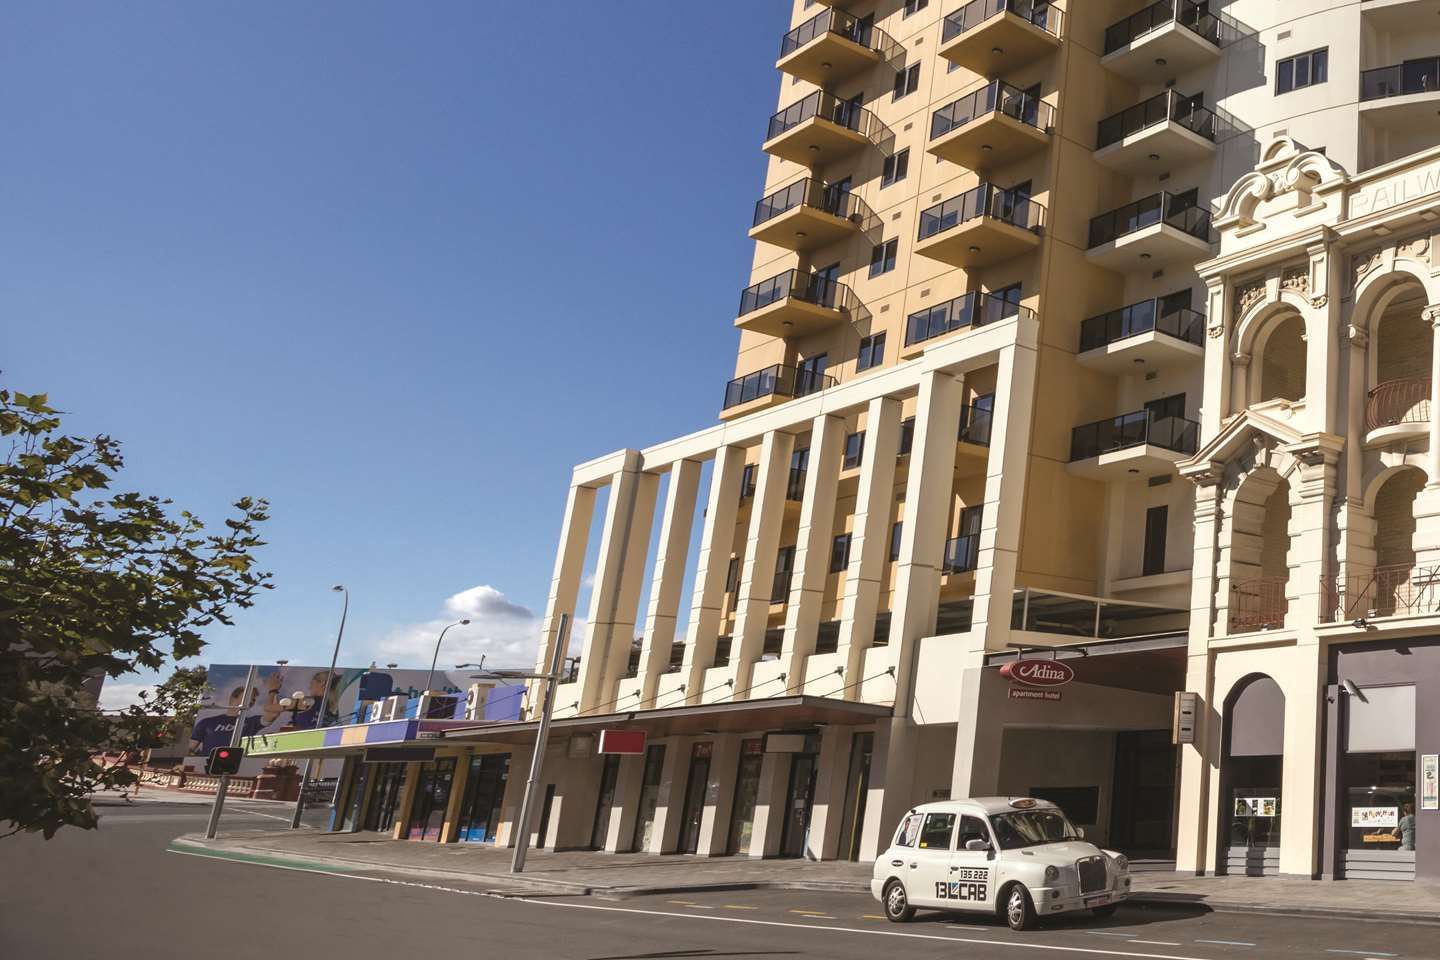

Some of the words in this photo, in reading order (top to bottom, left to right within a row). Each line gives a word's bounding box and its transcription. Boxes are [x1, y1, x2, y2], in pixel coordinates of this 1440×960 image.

[1019, 664, 1065, 680] Adina
[1012, 690, 1044, 699] apartment
[960, 870, 973, 879] 135
[973, 870, 989, 879] 222
